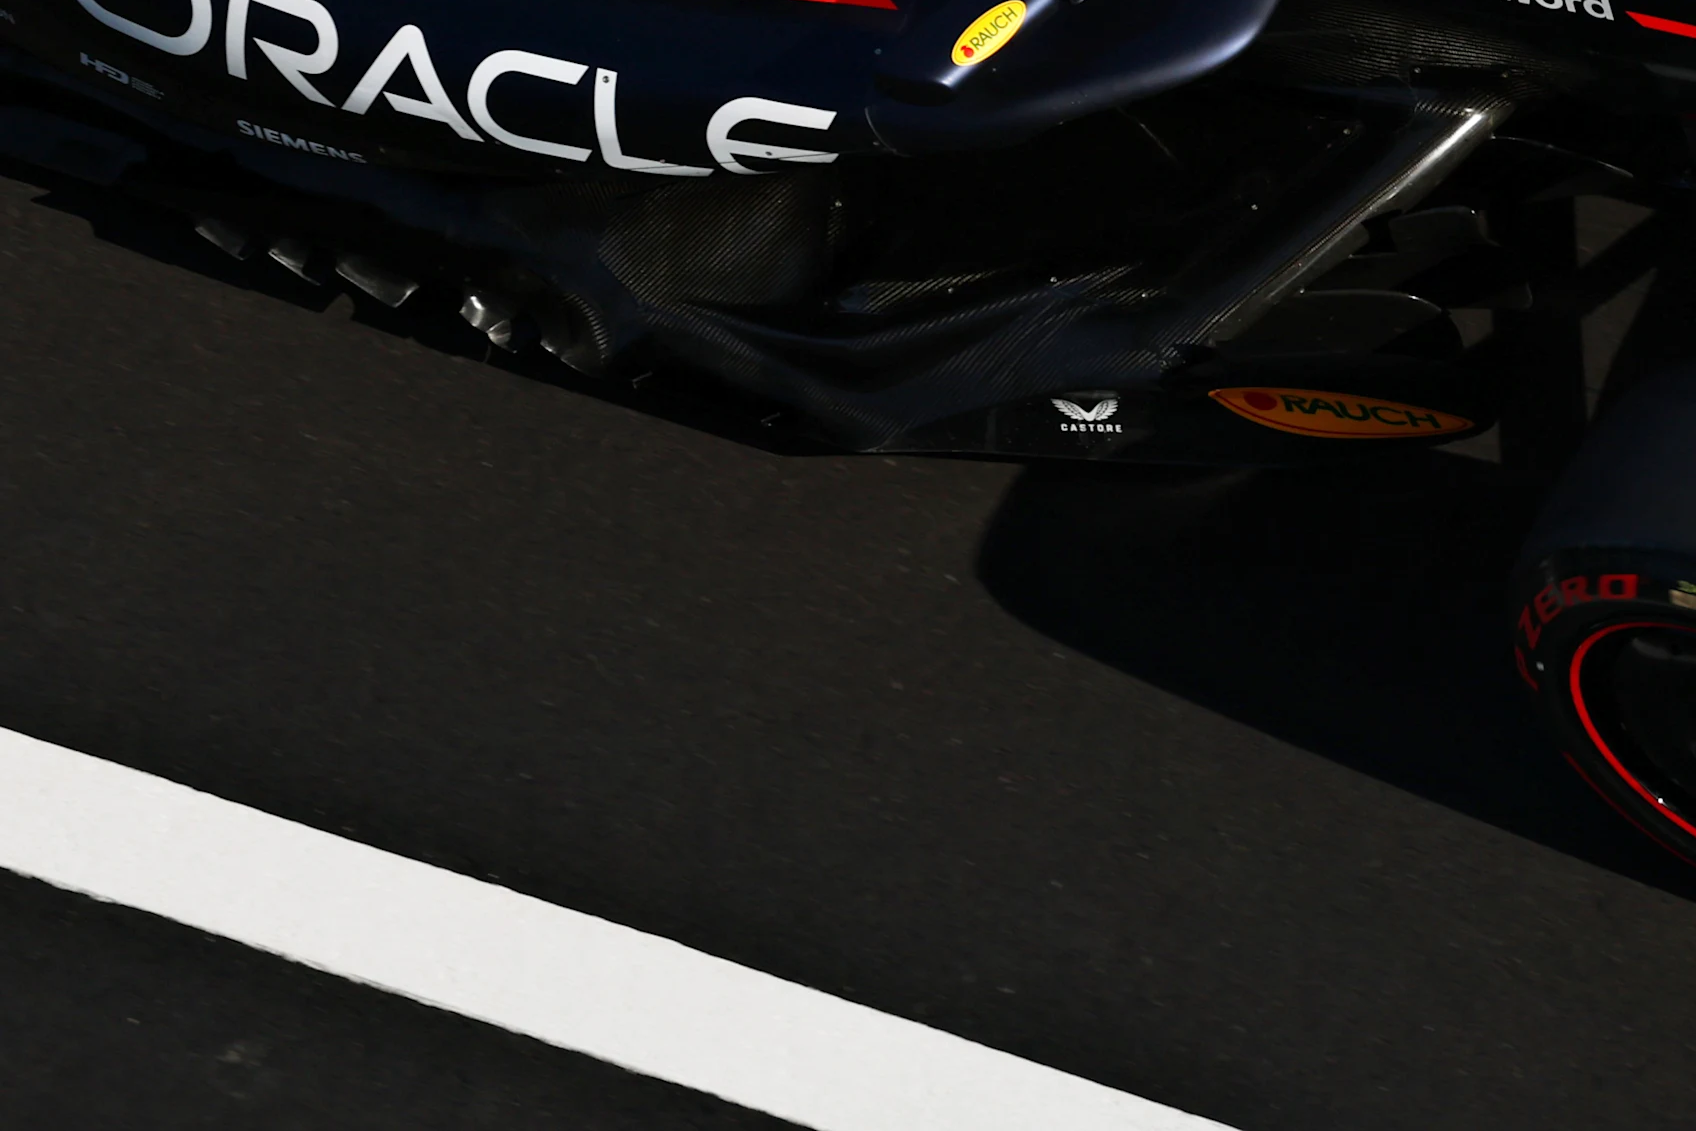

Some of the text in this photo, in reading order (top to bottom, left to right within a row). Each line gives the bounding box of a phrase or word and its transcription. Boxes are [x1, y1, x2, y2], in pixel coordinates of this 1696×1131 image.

[971, 6, 1018, 53] RAUCH
[236, 119, 368, 165] SIEMENS
[1059, 423, 1124, 434] CASTORE
[1281, 394, 1440, 430] RAUCH
[1518, 573, 1640, 651] ZERO
